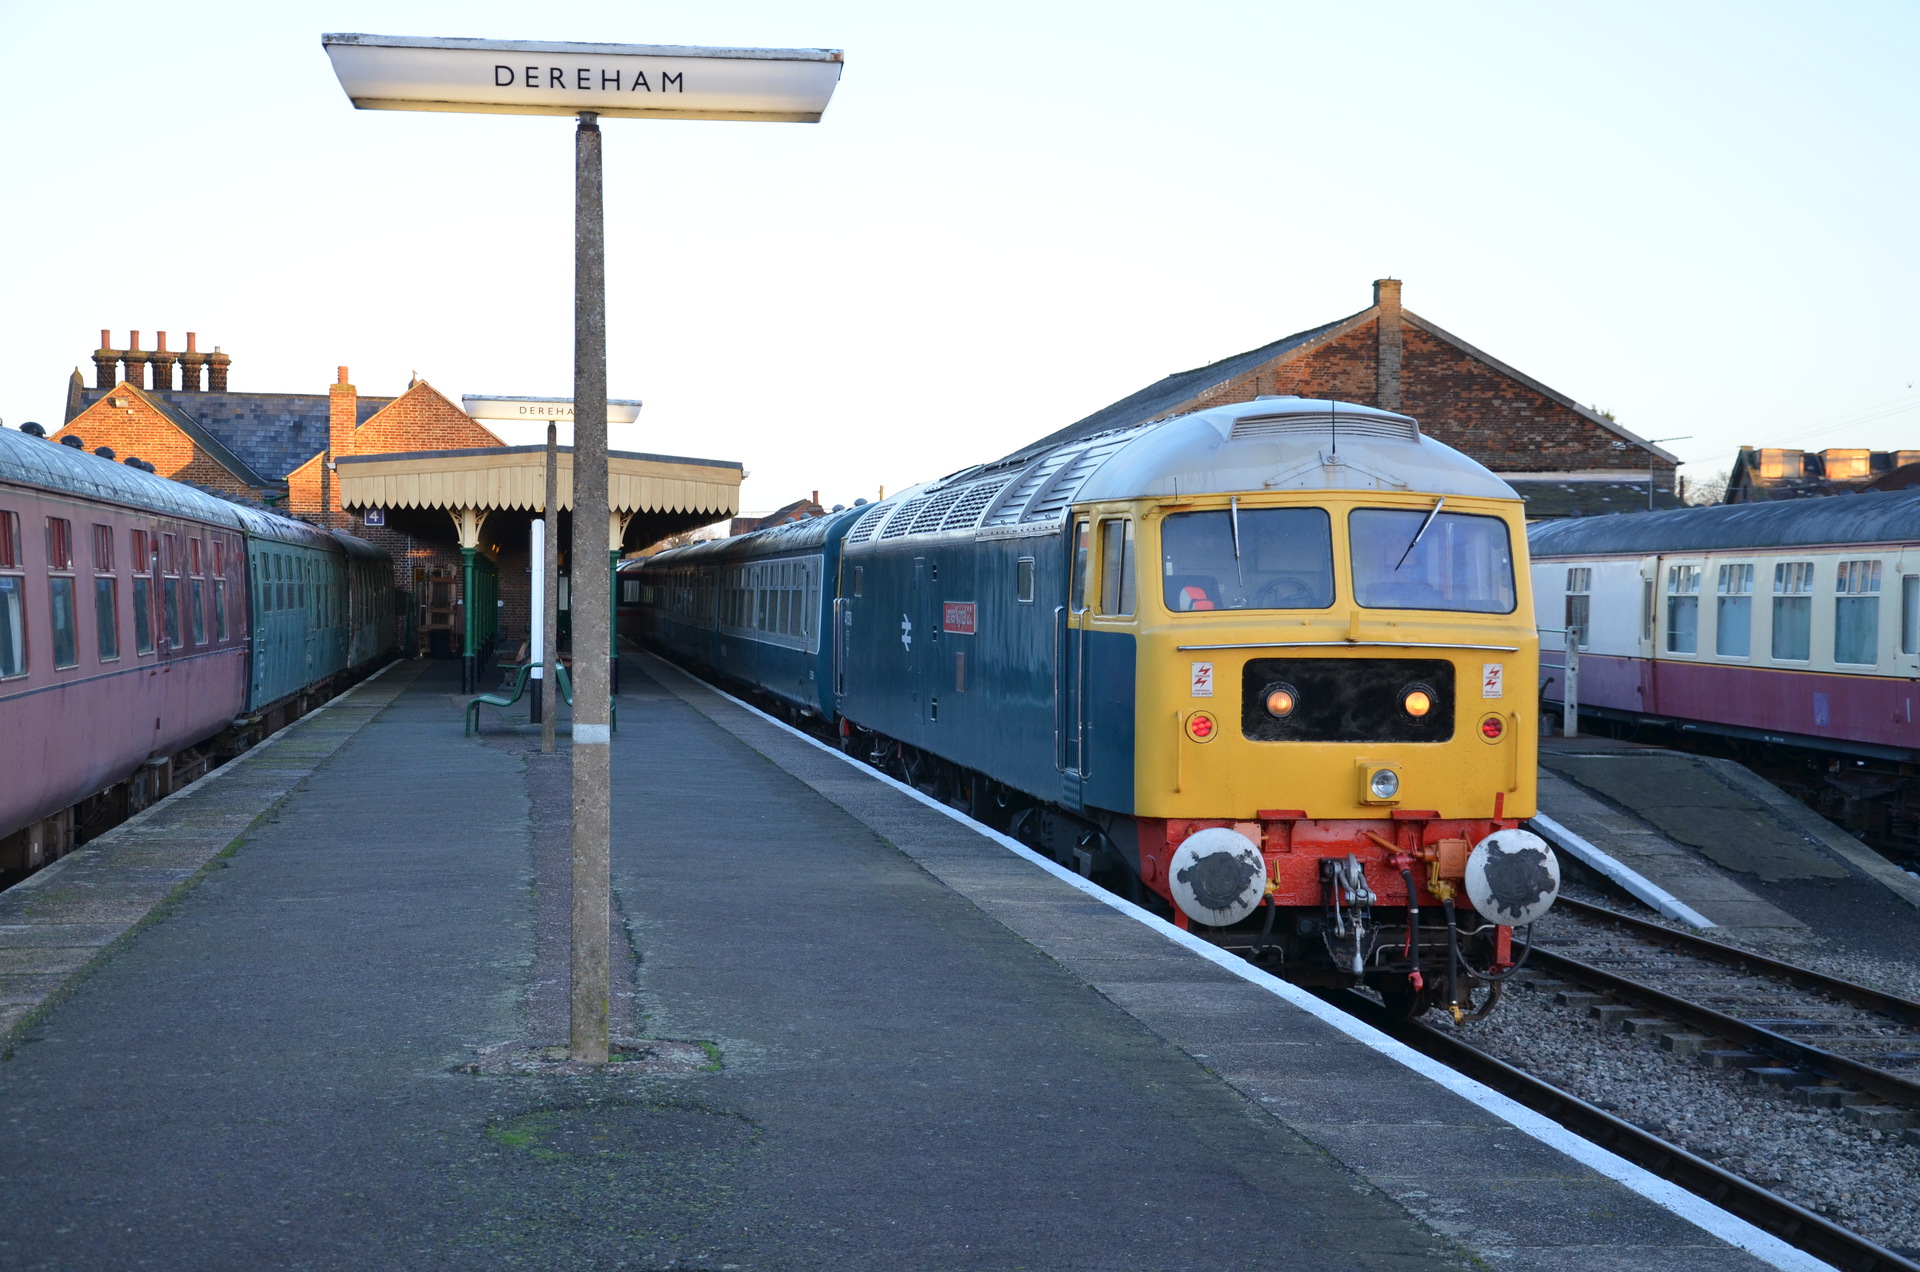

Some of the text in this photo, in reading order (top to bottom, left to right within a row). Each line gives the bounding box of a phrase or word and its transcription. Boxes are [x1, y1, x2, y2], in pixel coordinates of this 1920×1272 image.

[494, 65, 683, 93] DEREHAM
[519, 406, 575, 416] DEREHA
[369, 510, 379, 522] 4
